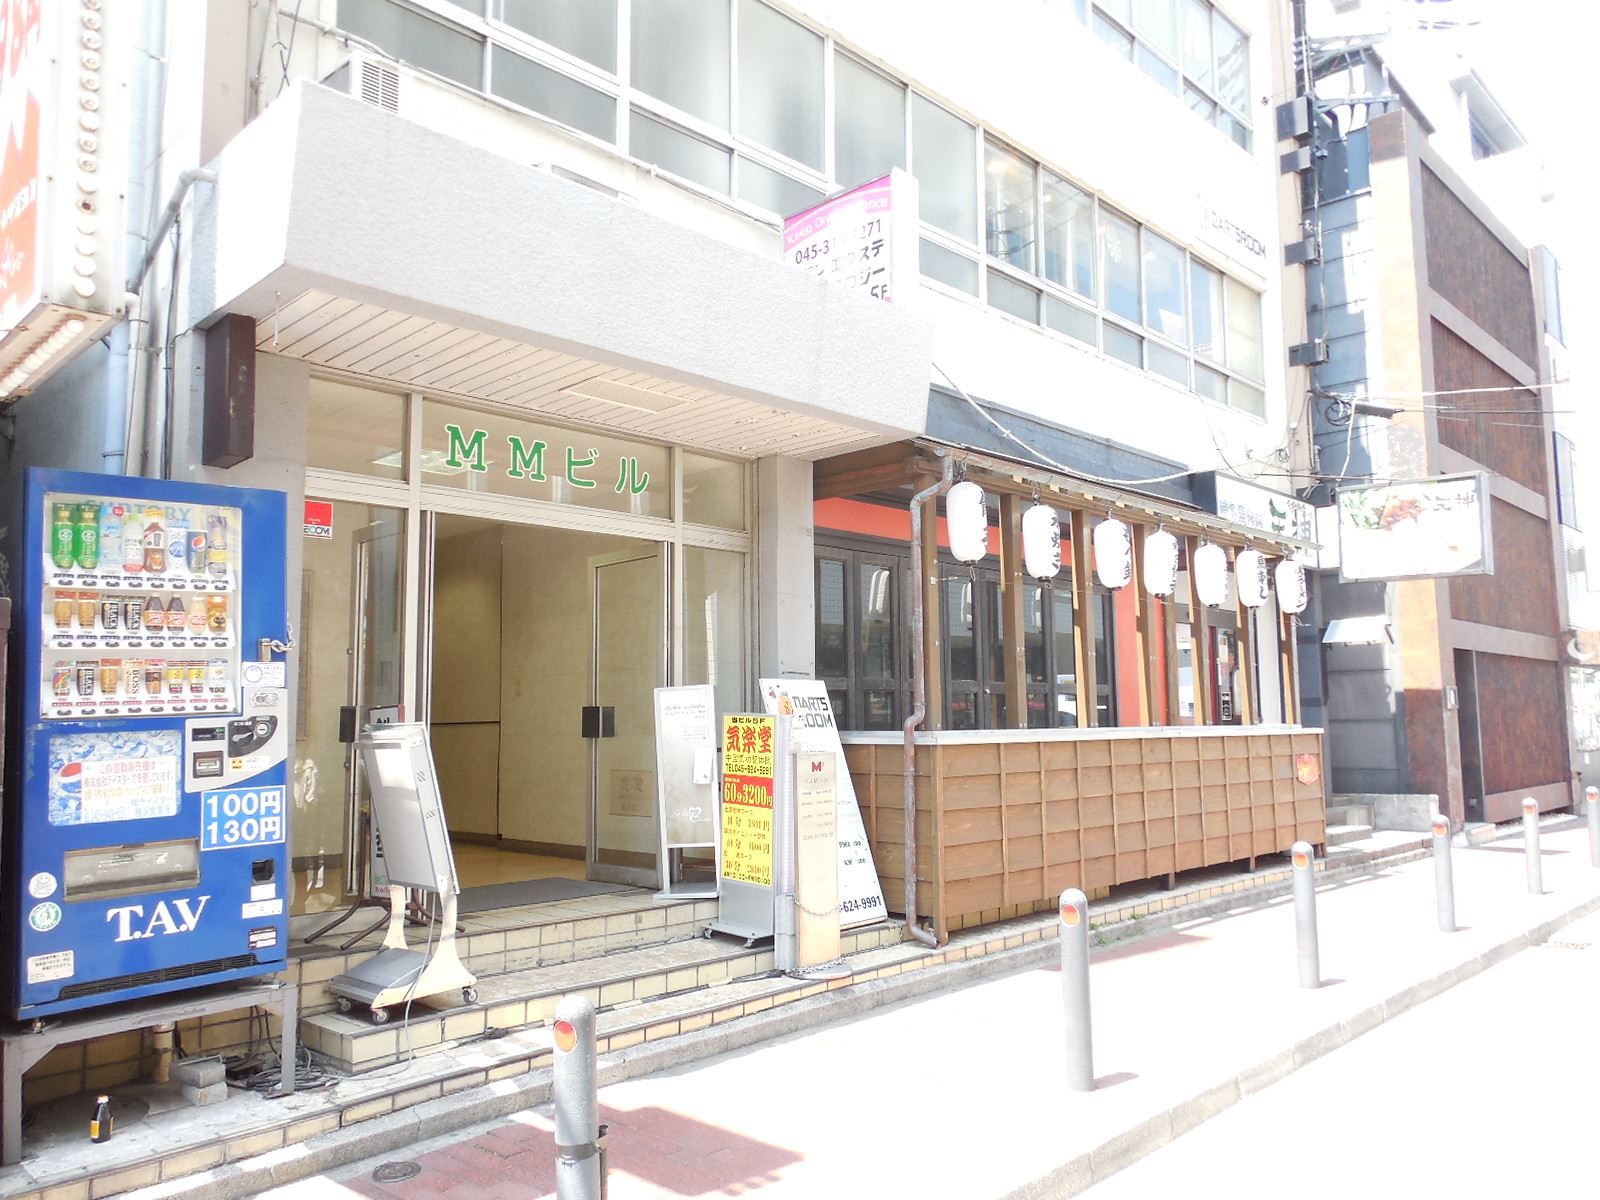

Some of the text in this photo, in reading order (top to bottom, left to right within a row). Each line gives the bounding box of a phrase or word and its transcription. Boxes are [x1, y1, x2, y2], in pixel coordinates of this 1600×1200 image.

[726, 725, 772, 754] 気楽堂
[206, 790, 281, 818] 100円
[206, 816, 282, 844] 130円
